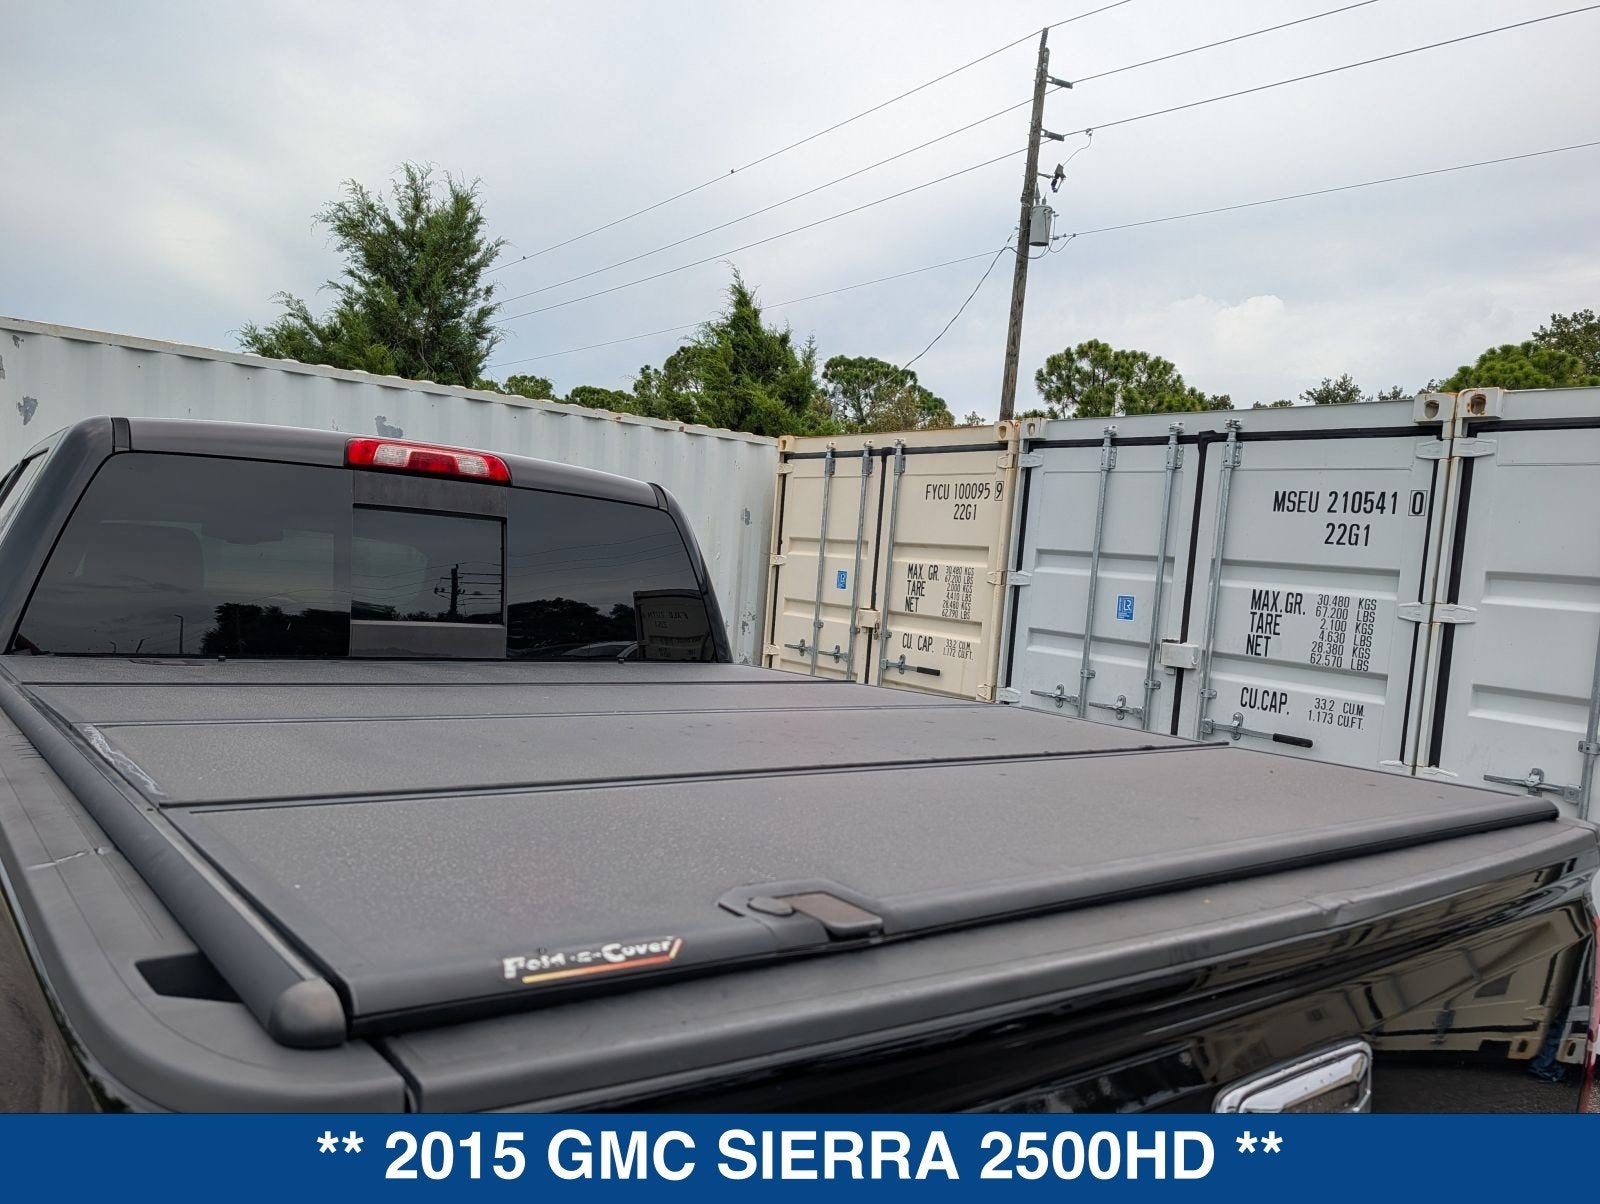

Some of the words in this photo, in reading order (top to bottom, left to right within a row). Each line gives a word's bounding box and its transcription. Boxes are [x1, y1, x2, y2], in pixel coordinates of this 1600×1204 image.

[925, 483, 950, 500] FYCU
[954, 482, 991, 500] 100095
[995, 481, 1003, 500] 9
[953, 503, 977, 520] 22G1
[1273, 490, 1320, 513] MSEU
[1327, 490, 1398, 515] 210541
[1324, 522, 1370, 547] 22G1
[928, 564, 940, 582] GR.
[907, 579, 926, 597] TARE
[904, 596, 920, 613] NET
[1317, 594, 1350, 608] 30.480
[1358, 598, 1377, 610] KGS
[1250, 611, 1283, 636] TARE
[1315, 606, 1349, 620] 67.200
[1356, 610, 1376, 623] LBS
[1320, 619, 1347, 632] 2.100
[1355, 623, 1374, 635] KGS
[1245, 634, 1272, 657] NET
[1318, 630, 1346, 644] 4.630
[1353, 634, 1373, 647] LBS
[1311, 641, 1345, 656] 28.380
[1351, 646, 1371, 659] KGS
[1309, 653, 1343, 668] 62.570
[1350, 658, 1369, 672] LBS
[1308, 709, 1334, 725] 1.173
